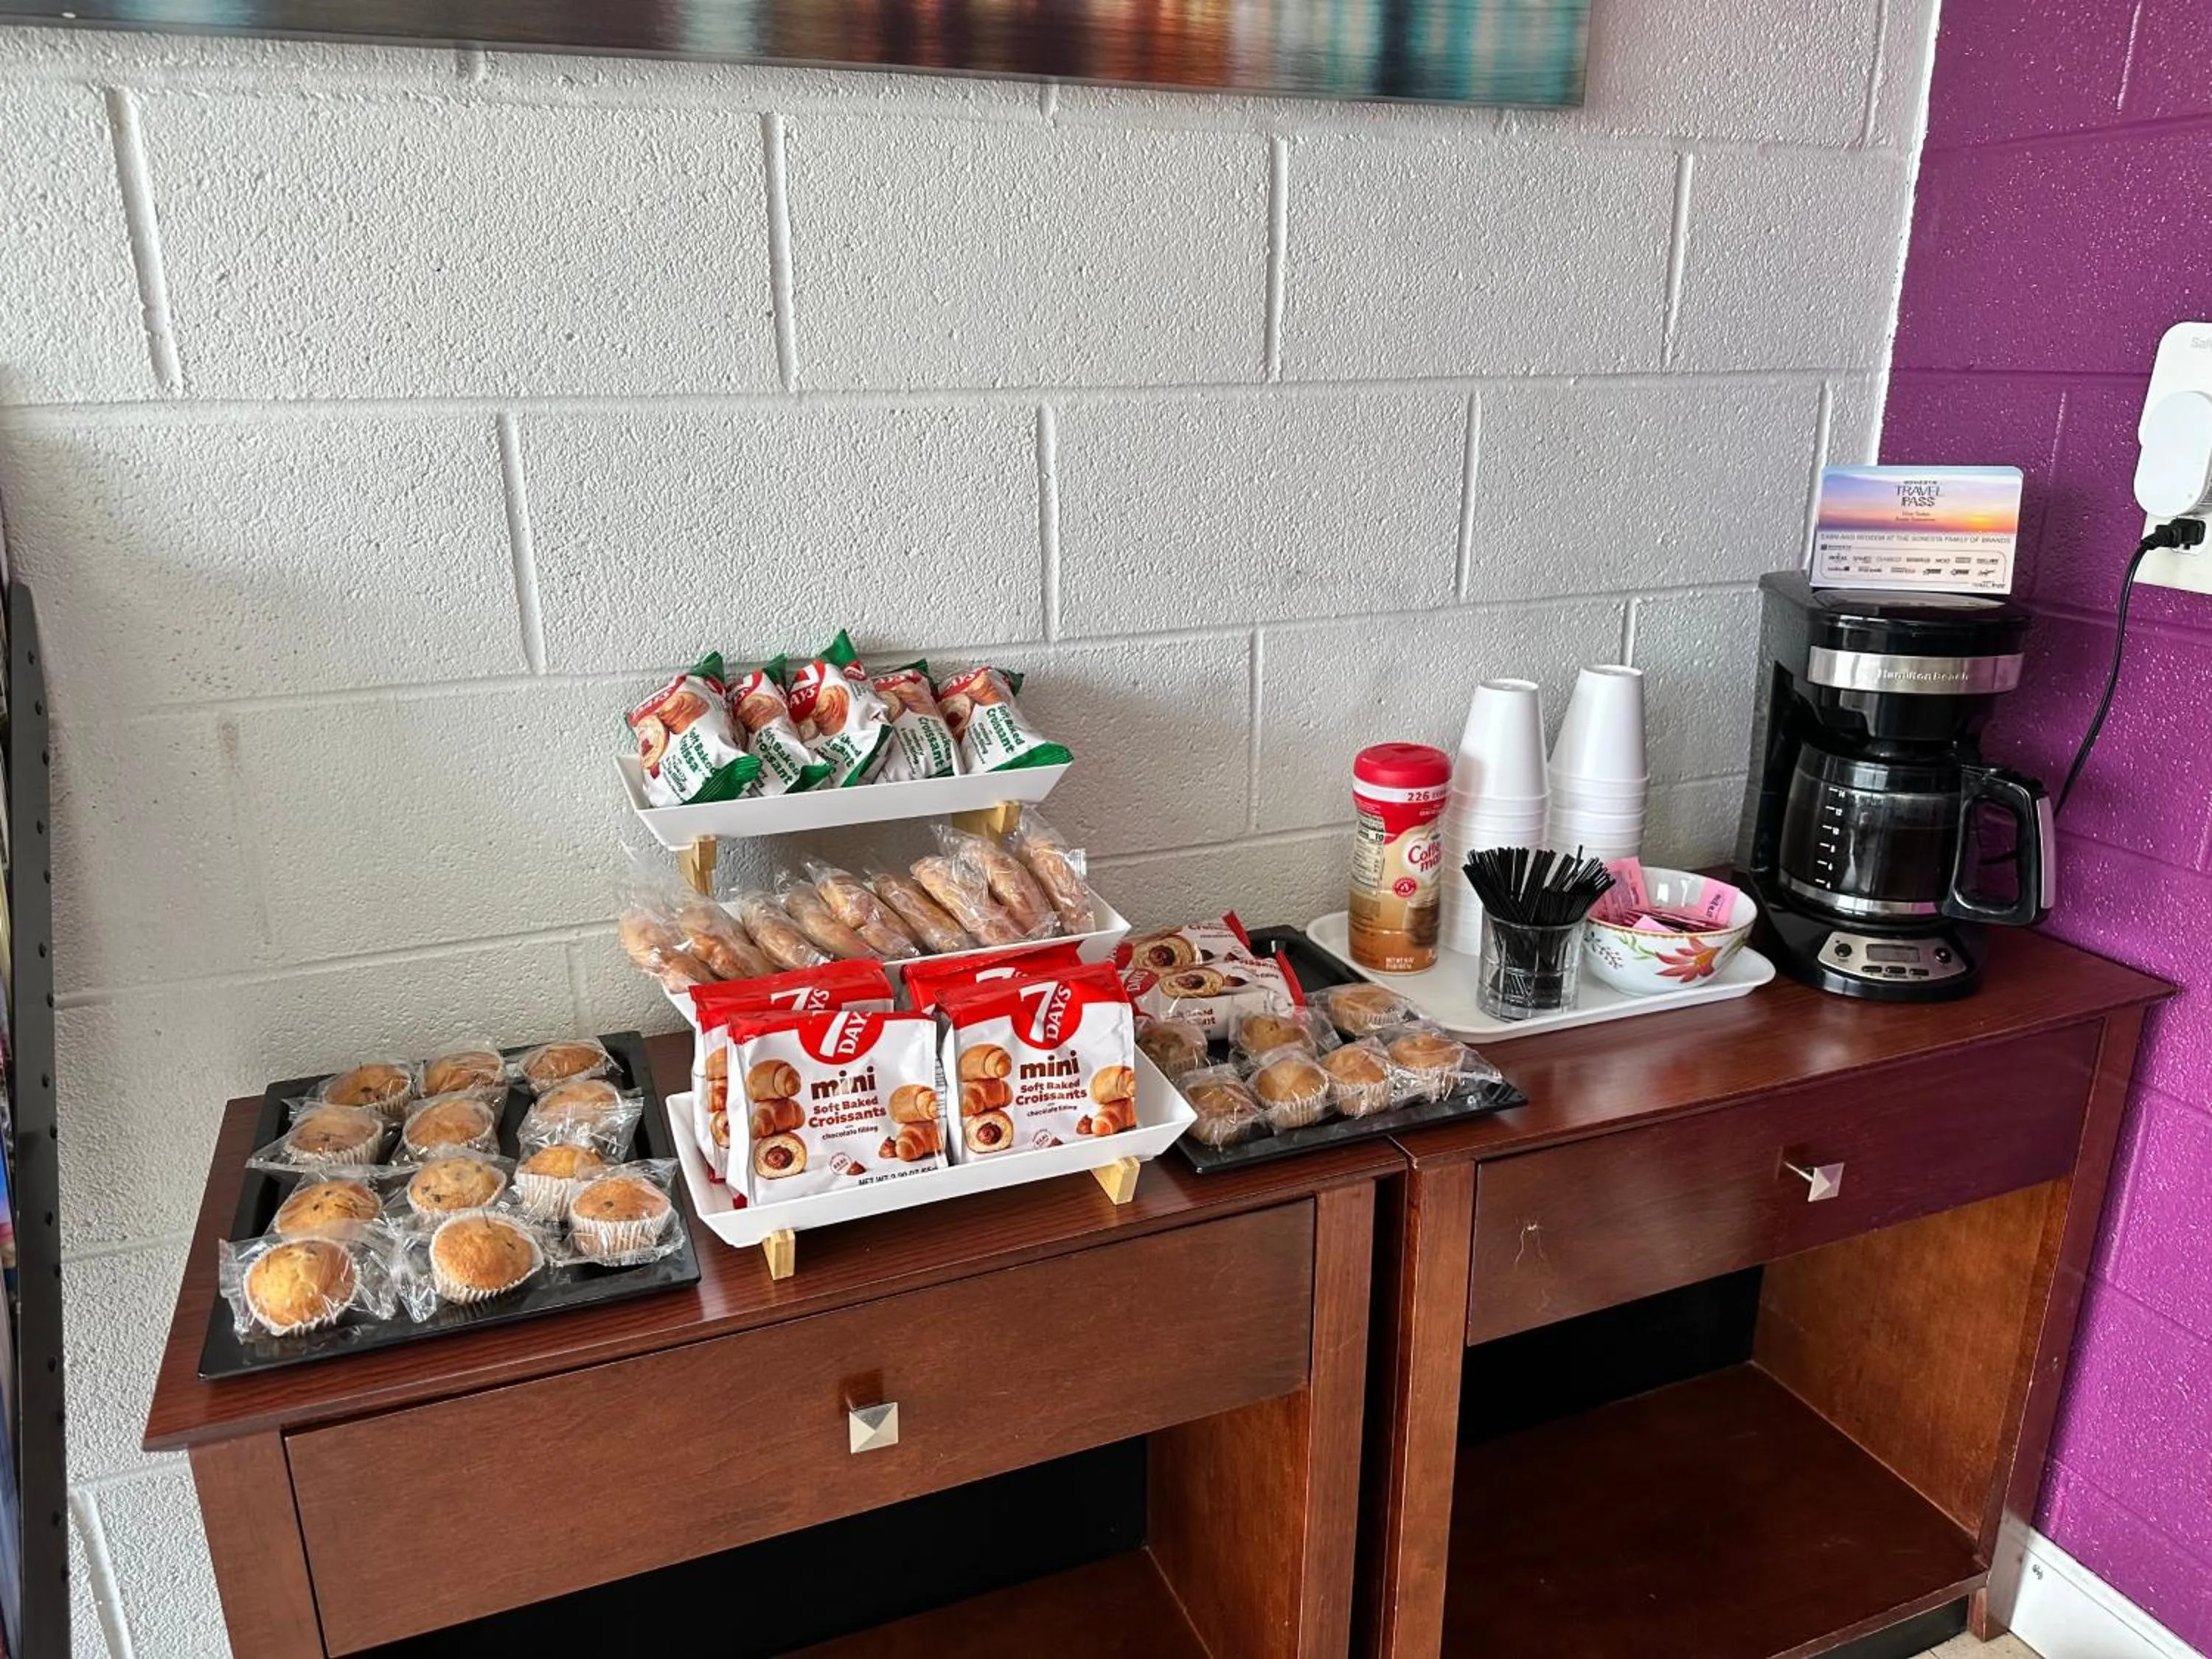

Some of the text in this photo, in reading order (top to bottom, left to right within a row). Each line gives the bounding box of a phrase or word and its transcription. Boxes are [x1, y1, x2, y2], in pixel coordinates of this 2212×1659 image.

[1896, 484, 1944, 497] TRAVEL
[1901, 496, 1936, 507] PASS
[986, 708, 1015, 754] Croissant
[1408, 791, 1430, 801] 226
[807, 988, 830, 1011] YS
[1019, 981, 1072, 1043] 7 DAYS
[838, 1011, 872, 1055] DAY
[1019, 1050, 1080, 1081] mini
[810, 1065, 876, 1100] mini
[1020, 1077, 1080, 1093] Soft Baked
[813, 1095, 879, 1115] Soft Baked
[1015, 1089, 1088, 1106] Croissants
[807, 1106, 887, 1128] Croissants
[822, 1129, 857, 1141] chocolate
